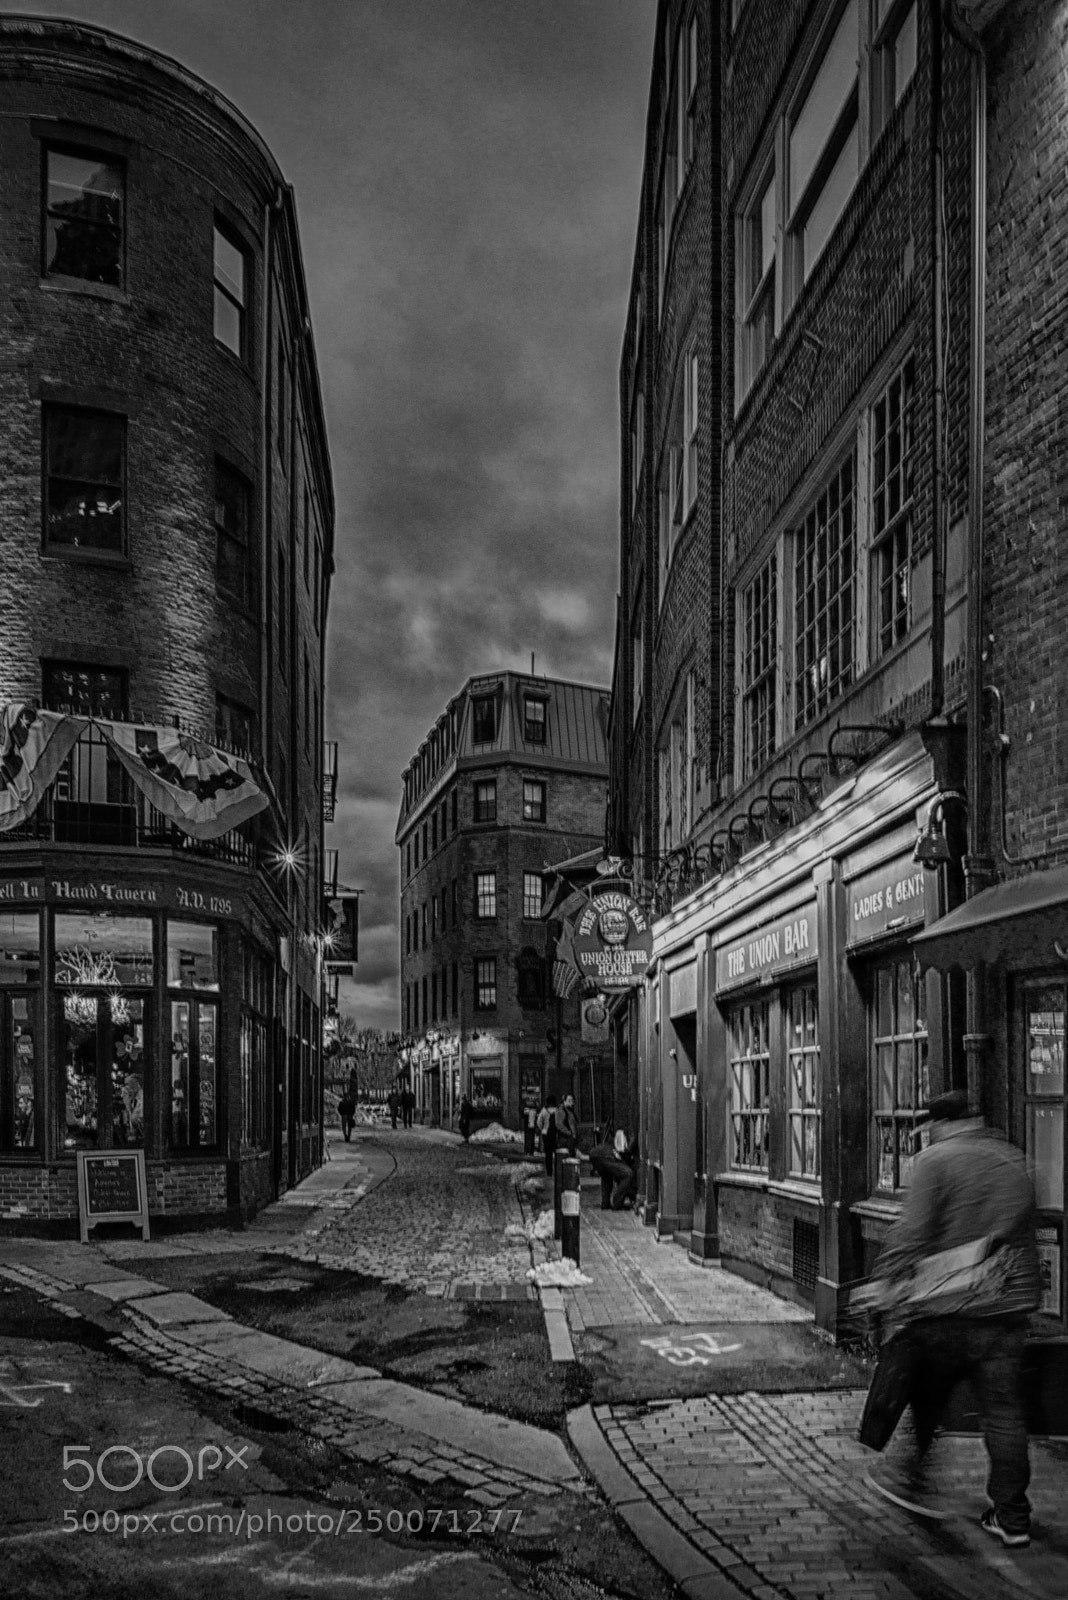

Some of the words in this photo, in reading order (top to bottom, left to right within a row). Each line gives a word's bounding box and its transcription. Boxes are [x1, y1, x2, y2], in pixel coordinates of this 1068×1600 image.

[51, 881, 98, 899] Hand
[100, 883, 157, 902] Tavern
[854, 891, 883, 921] LADIES
[885, 886, 893, 909] &
[579, 909, 597, 936] THE
[593, 895, 631, 912] UNION
[580, 951, 612, 966] UNION
[613, 949, 649, 964] OYSTER
[727, 948, 746, 977] THE
[749, 931, 780, 970] UNION
[784, 919, 809, 954] BAR
[598, 961, 633, 976] HOUSE
